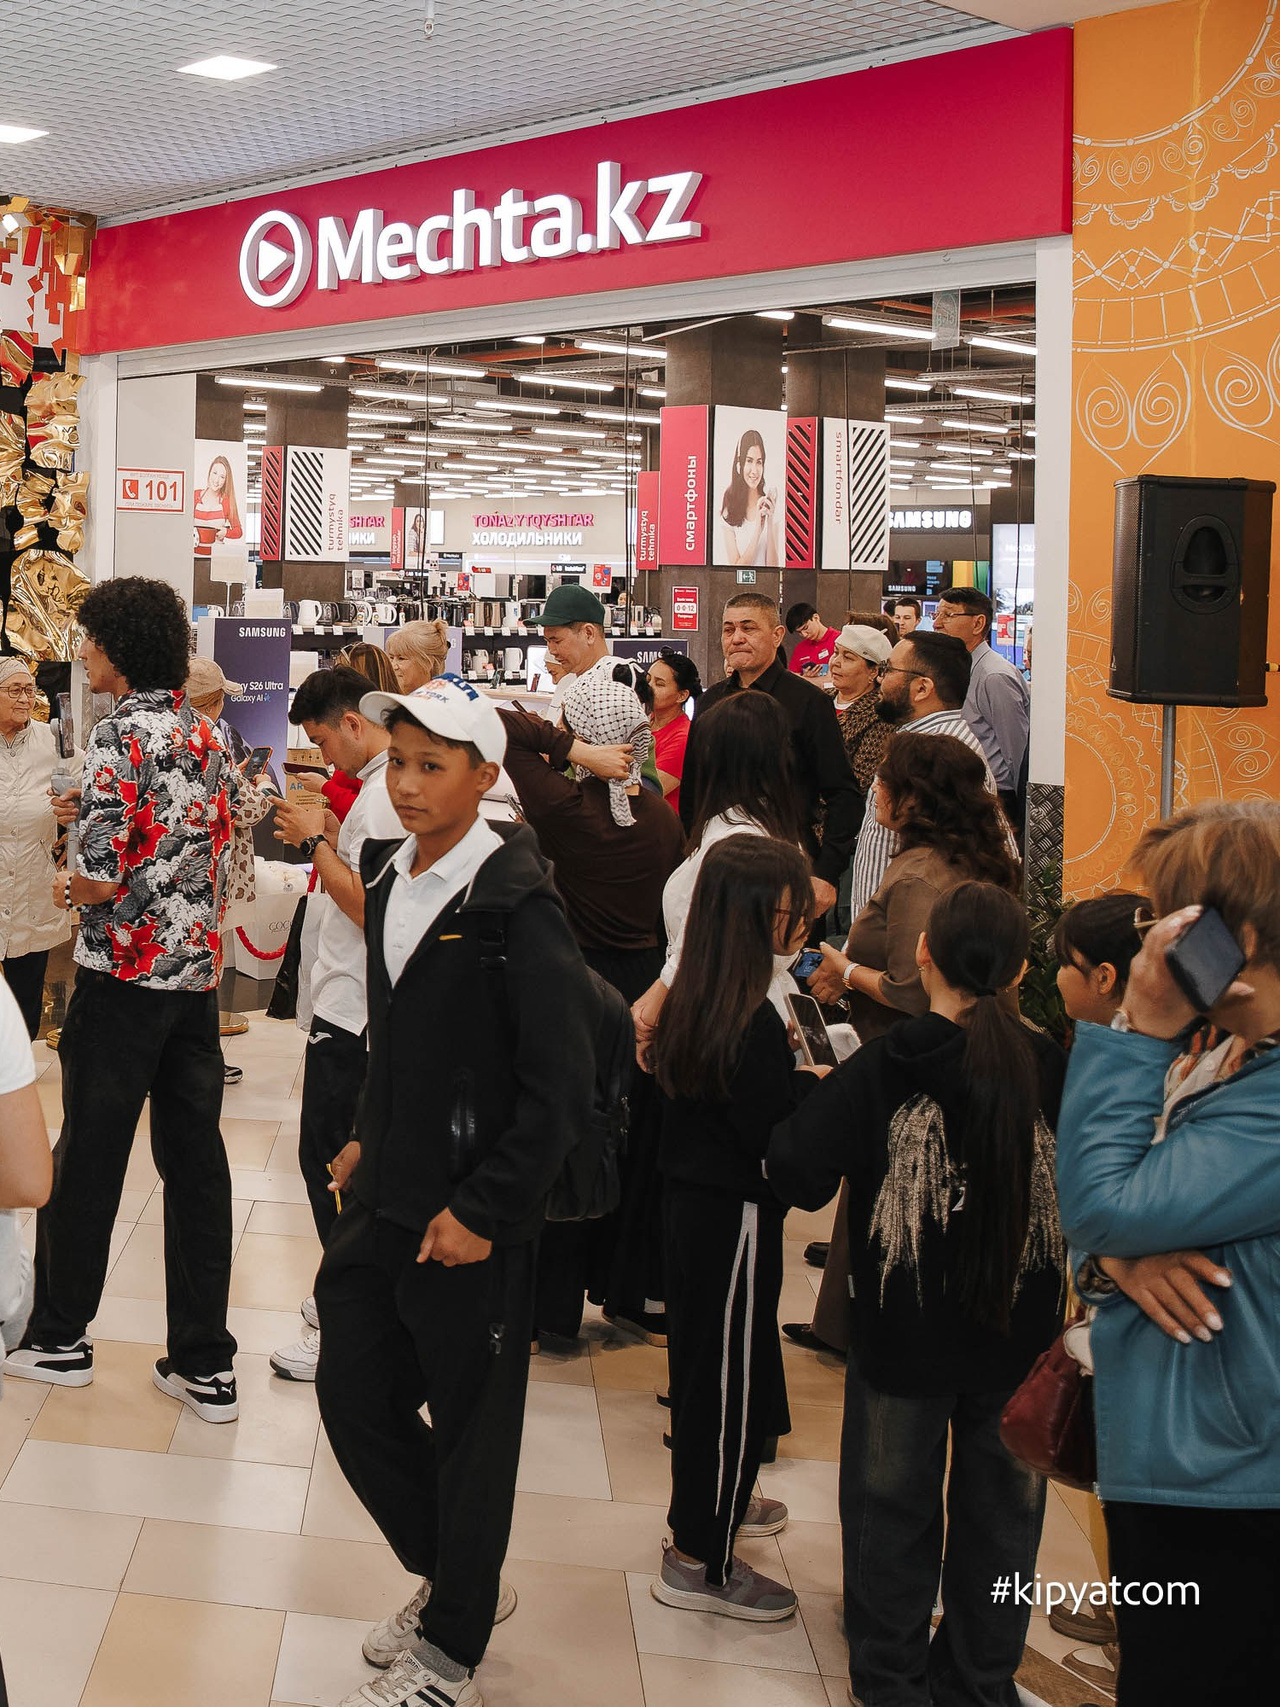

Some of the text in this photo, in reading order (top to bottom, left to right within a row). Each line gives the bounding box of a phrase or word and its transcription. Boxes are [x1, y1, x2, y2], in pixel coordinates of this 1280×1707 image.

[317, 160, 703, 291] Mechta.kz
[145, 479, 177, 501] 101
[835, 431, 844, 525] smartfondar
[327, 493, 337, 551] turmystyq
[683, 455, 699, 551] смартфоны
[336, 509, 344, 551] tehnika
[471, 531, 583, 548] ХОЛОДИЛЬНИКИ
[639, 510, 649, 561] turmystyq
[647, 523, 656, 561] tehnika
[887, 584, 917, 593] SAMSUNG
[238, 626, 287, 638] SAMSUNG
[230, 693, 256, 704] Galaxy
[249, 680, 264, 691] S26
[264, 680, 284, 691] Ultra
